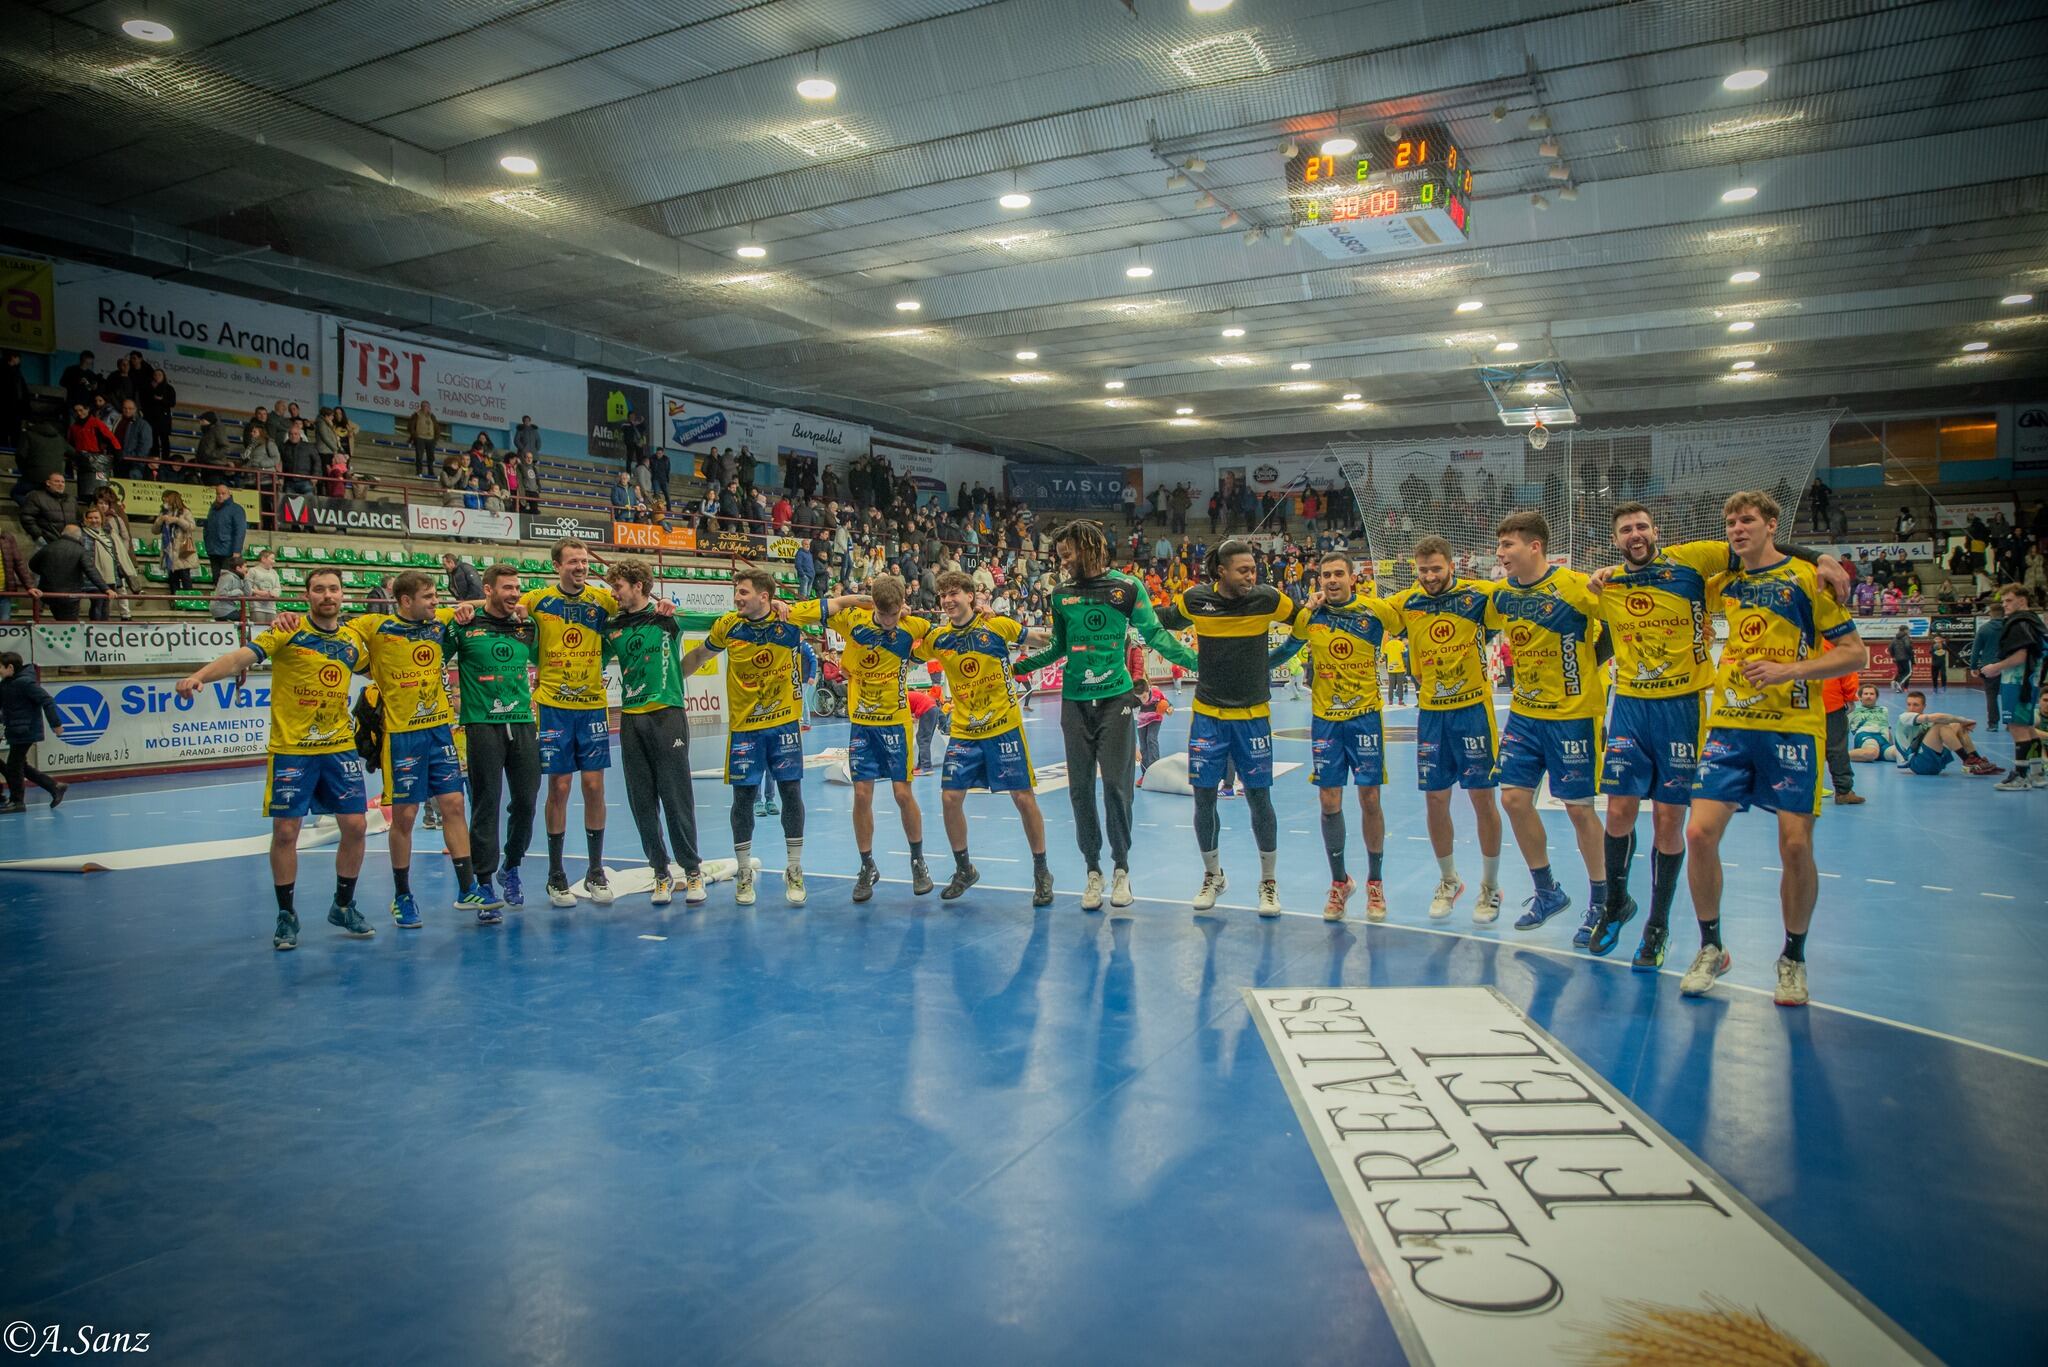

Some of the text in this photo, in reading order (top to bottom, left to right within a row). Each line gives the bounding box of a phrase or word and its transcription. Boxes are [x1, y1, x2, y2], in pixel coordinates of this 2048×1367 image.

[1396, 141, 1426, 168] 21
[1356, 160, 1369, 181] 2
[1391, 168, 1428, 184] VISITANTE
[1422, 184, 1434, 203] 0
[98, 297, 310, 361] Rótulos Aranda
[163, 359, 229, 381] Especializado
[230, 371, 242, 381] de
[245, 373, 292, 390] Rotulación
[349, 340, 426, 396] TBT
[436, 371, 507, 393] LOGÍSTICA Y
[355, 393, 369, 403] Tel.
[393, 399, 405, 408] 84
[438, 388, 507, 410] TRANSPORTE
[442, 406, 469, 418] Aranda
[483, 413, 505, 424] Duero
[680, 415, 720, 443] HERNANDO
[792, 422, 843, 446] Burpellet
[312, 507, 401, 530] VALCARCE
[416, 507, 448, 530] lens
[535, 527, 600, 540] DREAM TEAM
[1638, 616, 1690, 629] aranda
[84, 625, 234, 651] federópticos
[568, 648, 602, 658] aranda
[1440, 639, 1476, 654] aranda
[1745, 646, 1796, 658] aranda
[1338, 659, 1375, 671] aranda
[1561, 632, 1582, 697] BLASCON
[391, 669, 422, 681] tubos
[864, 670, 899, 679] aranda
[971, 671, 1002, 688] aranda
[1629, 675, 1691, 691] MICHELIN
[121, 681, 272, 715] Siro Vaz
[293, 686, 325, 699] tubos
[1429, 689, 1484, 706] MICHELIN
[484, 712, 530, 722] MICHELIN
[744, 708, 791, 725] MICHELIN
[852, 712, 893, 722] MICHELIN
[1324, 705, 1376, 718] MICHELIN
[1714, 708, 1784, 721] MICHELIN
[172, 718, 264, 734] SANEAMIENTO
[588, 720, 609, 735] TBT
[145, 731, 264, 749] MOBILIARIO DE
[778, 733, 800, 745] TBT
[882, 734, 900, 746] TBT
[998, 740, 1019, 754] TBT
[1249, 734, 1271, 750] TBT
[1355, 733, 1379, 748] TBT
[1462, 735, 1486, 751] TBT
[1560, 739, 1588, 754] TBT
[47, 750, 113, 766] C/ Puerta Nueva,
[179, 743, 258, 758] ARANDA BURGOS
[1669, 742, 1696, 758] TBT
[1775, 743, 1809, 761] TBT
[340, 760, 363, 774] TBT
[1411, 1028, 1733, 1220] FIEL
[1267, 993, 1565, 1318] CEREALES
